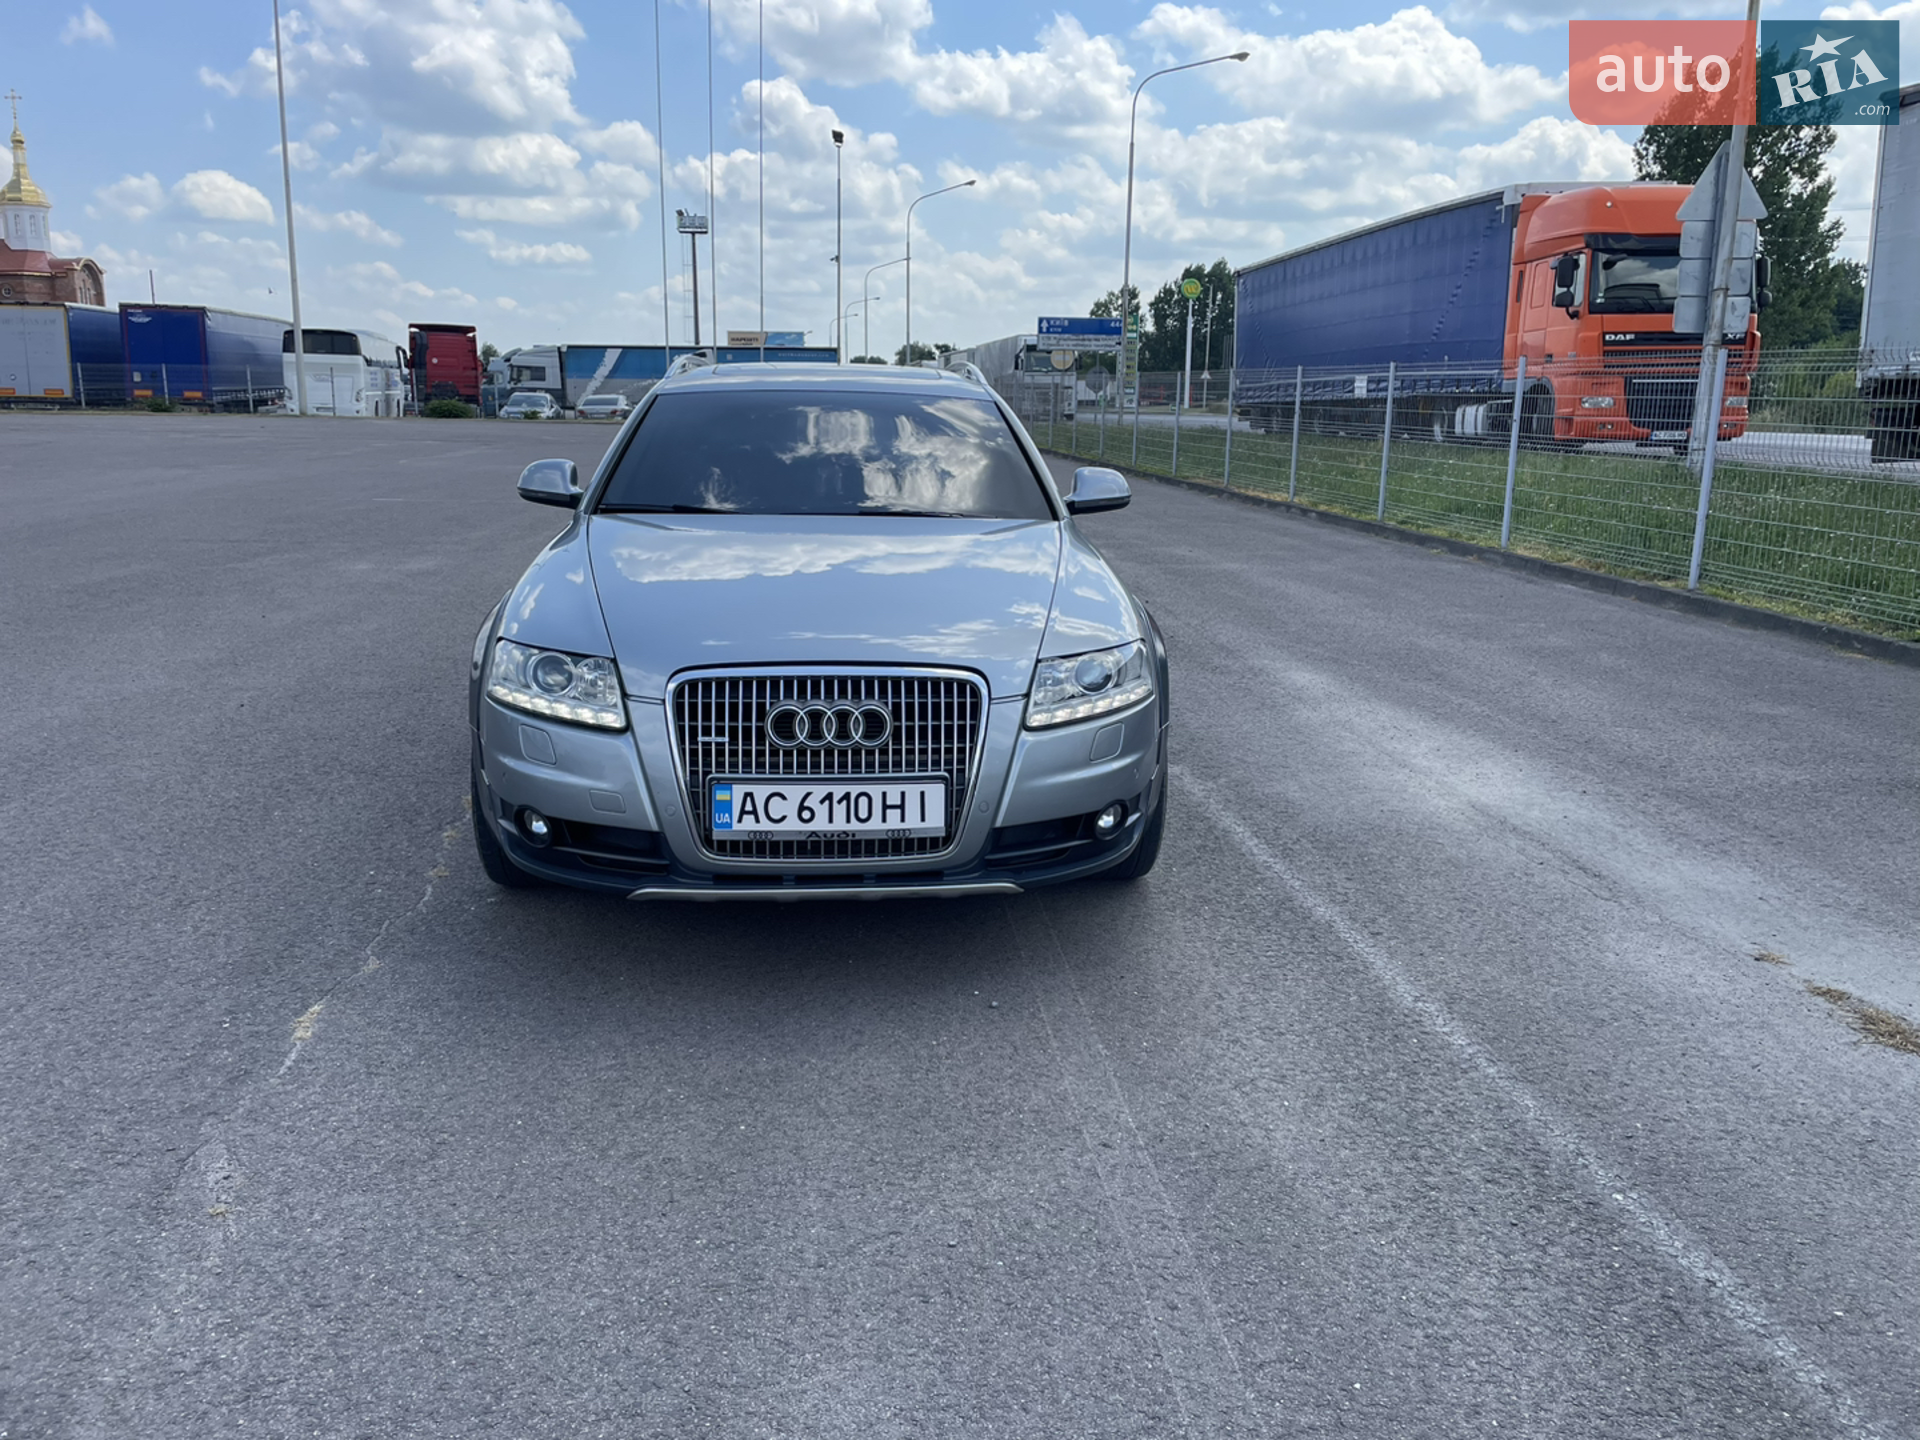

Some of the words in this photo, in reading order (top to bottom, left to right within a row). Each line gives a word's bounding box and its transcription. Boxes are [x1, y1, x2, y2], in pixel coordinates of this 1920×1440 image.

[1605, 333, 1636, 341] DAF
[737, 791, 788, 824] AC
[797, 791, 874, 824] 6110
[881, 790, 926, 824] HI
[715, 812, 731, 824] UA
[805, 831, 857, 840] Audi
